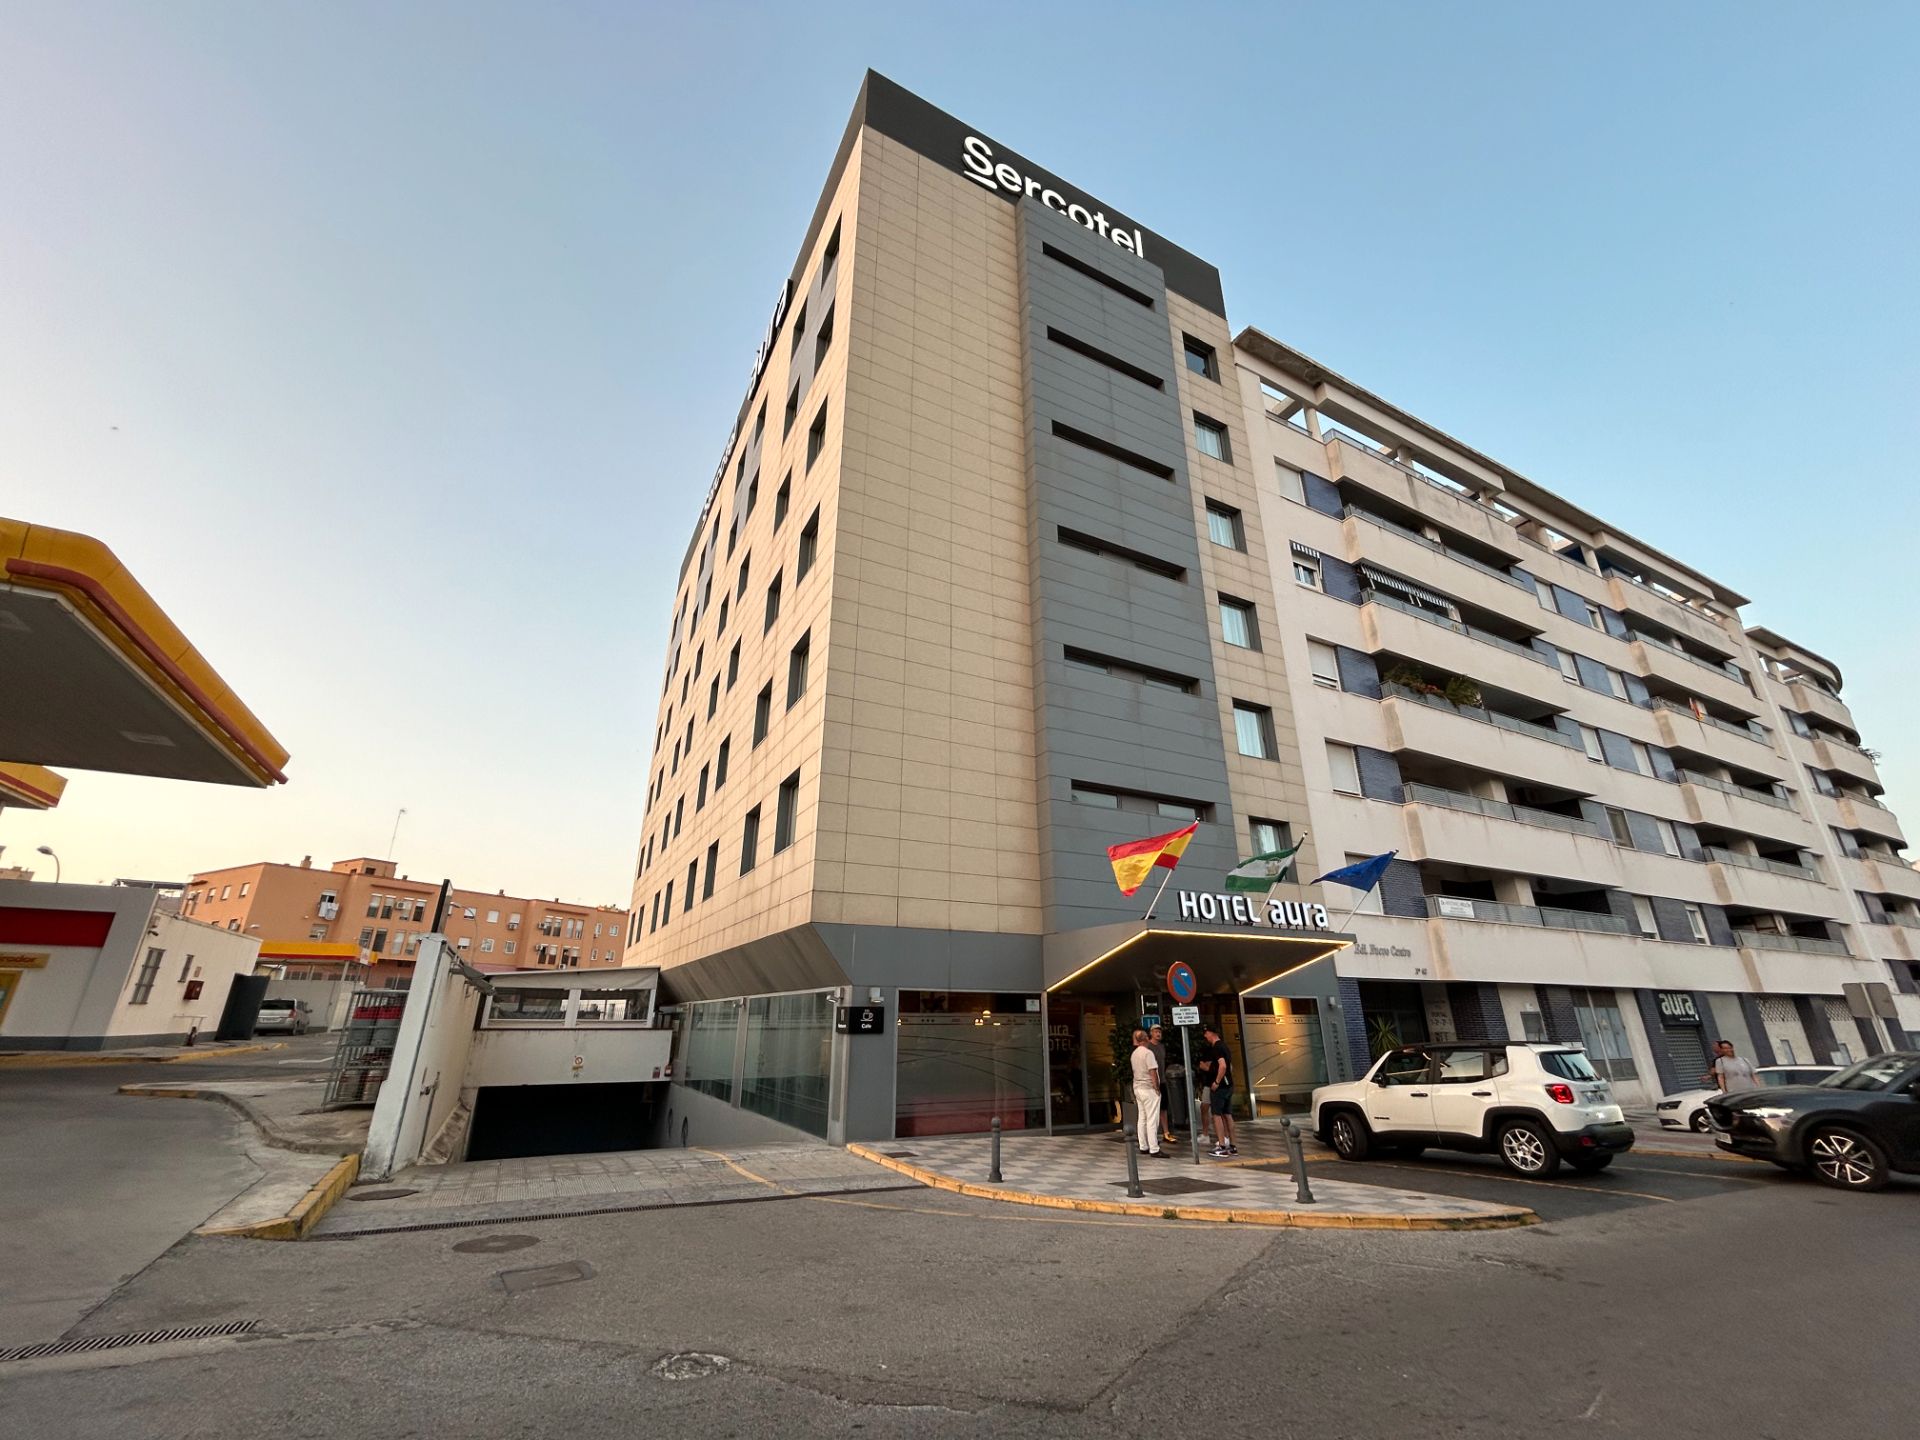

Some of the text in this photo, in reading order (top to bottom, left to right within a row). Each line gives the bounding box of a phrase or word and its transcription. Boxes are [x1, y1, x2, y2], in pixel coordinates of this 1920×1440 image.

[962, 136, 1144, 258] Sercotel
[1178, 890, 1330, 928] HOTEL aura
[1658, 993, 1695, 1016] aura
[1049, 1024, 1069, 1036] ura
[1049, 1038, 1075, 1051] OTEL
